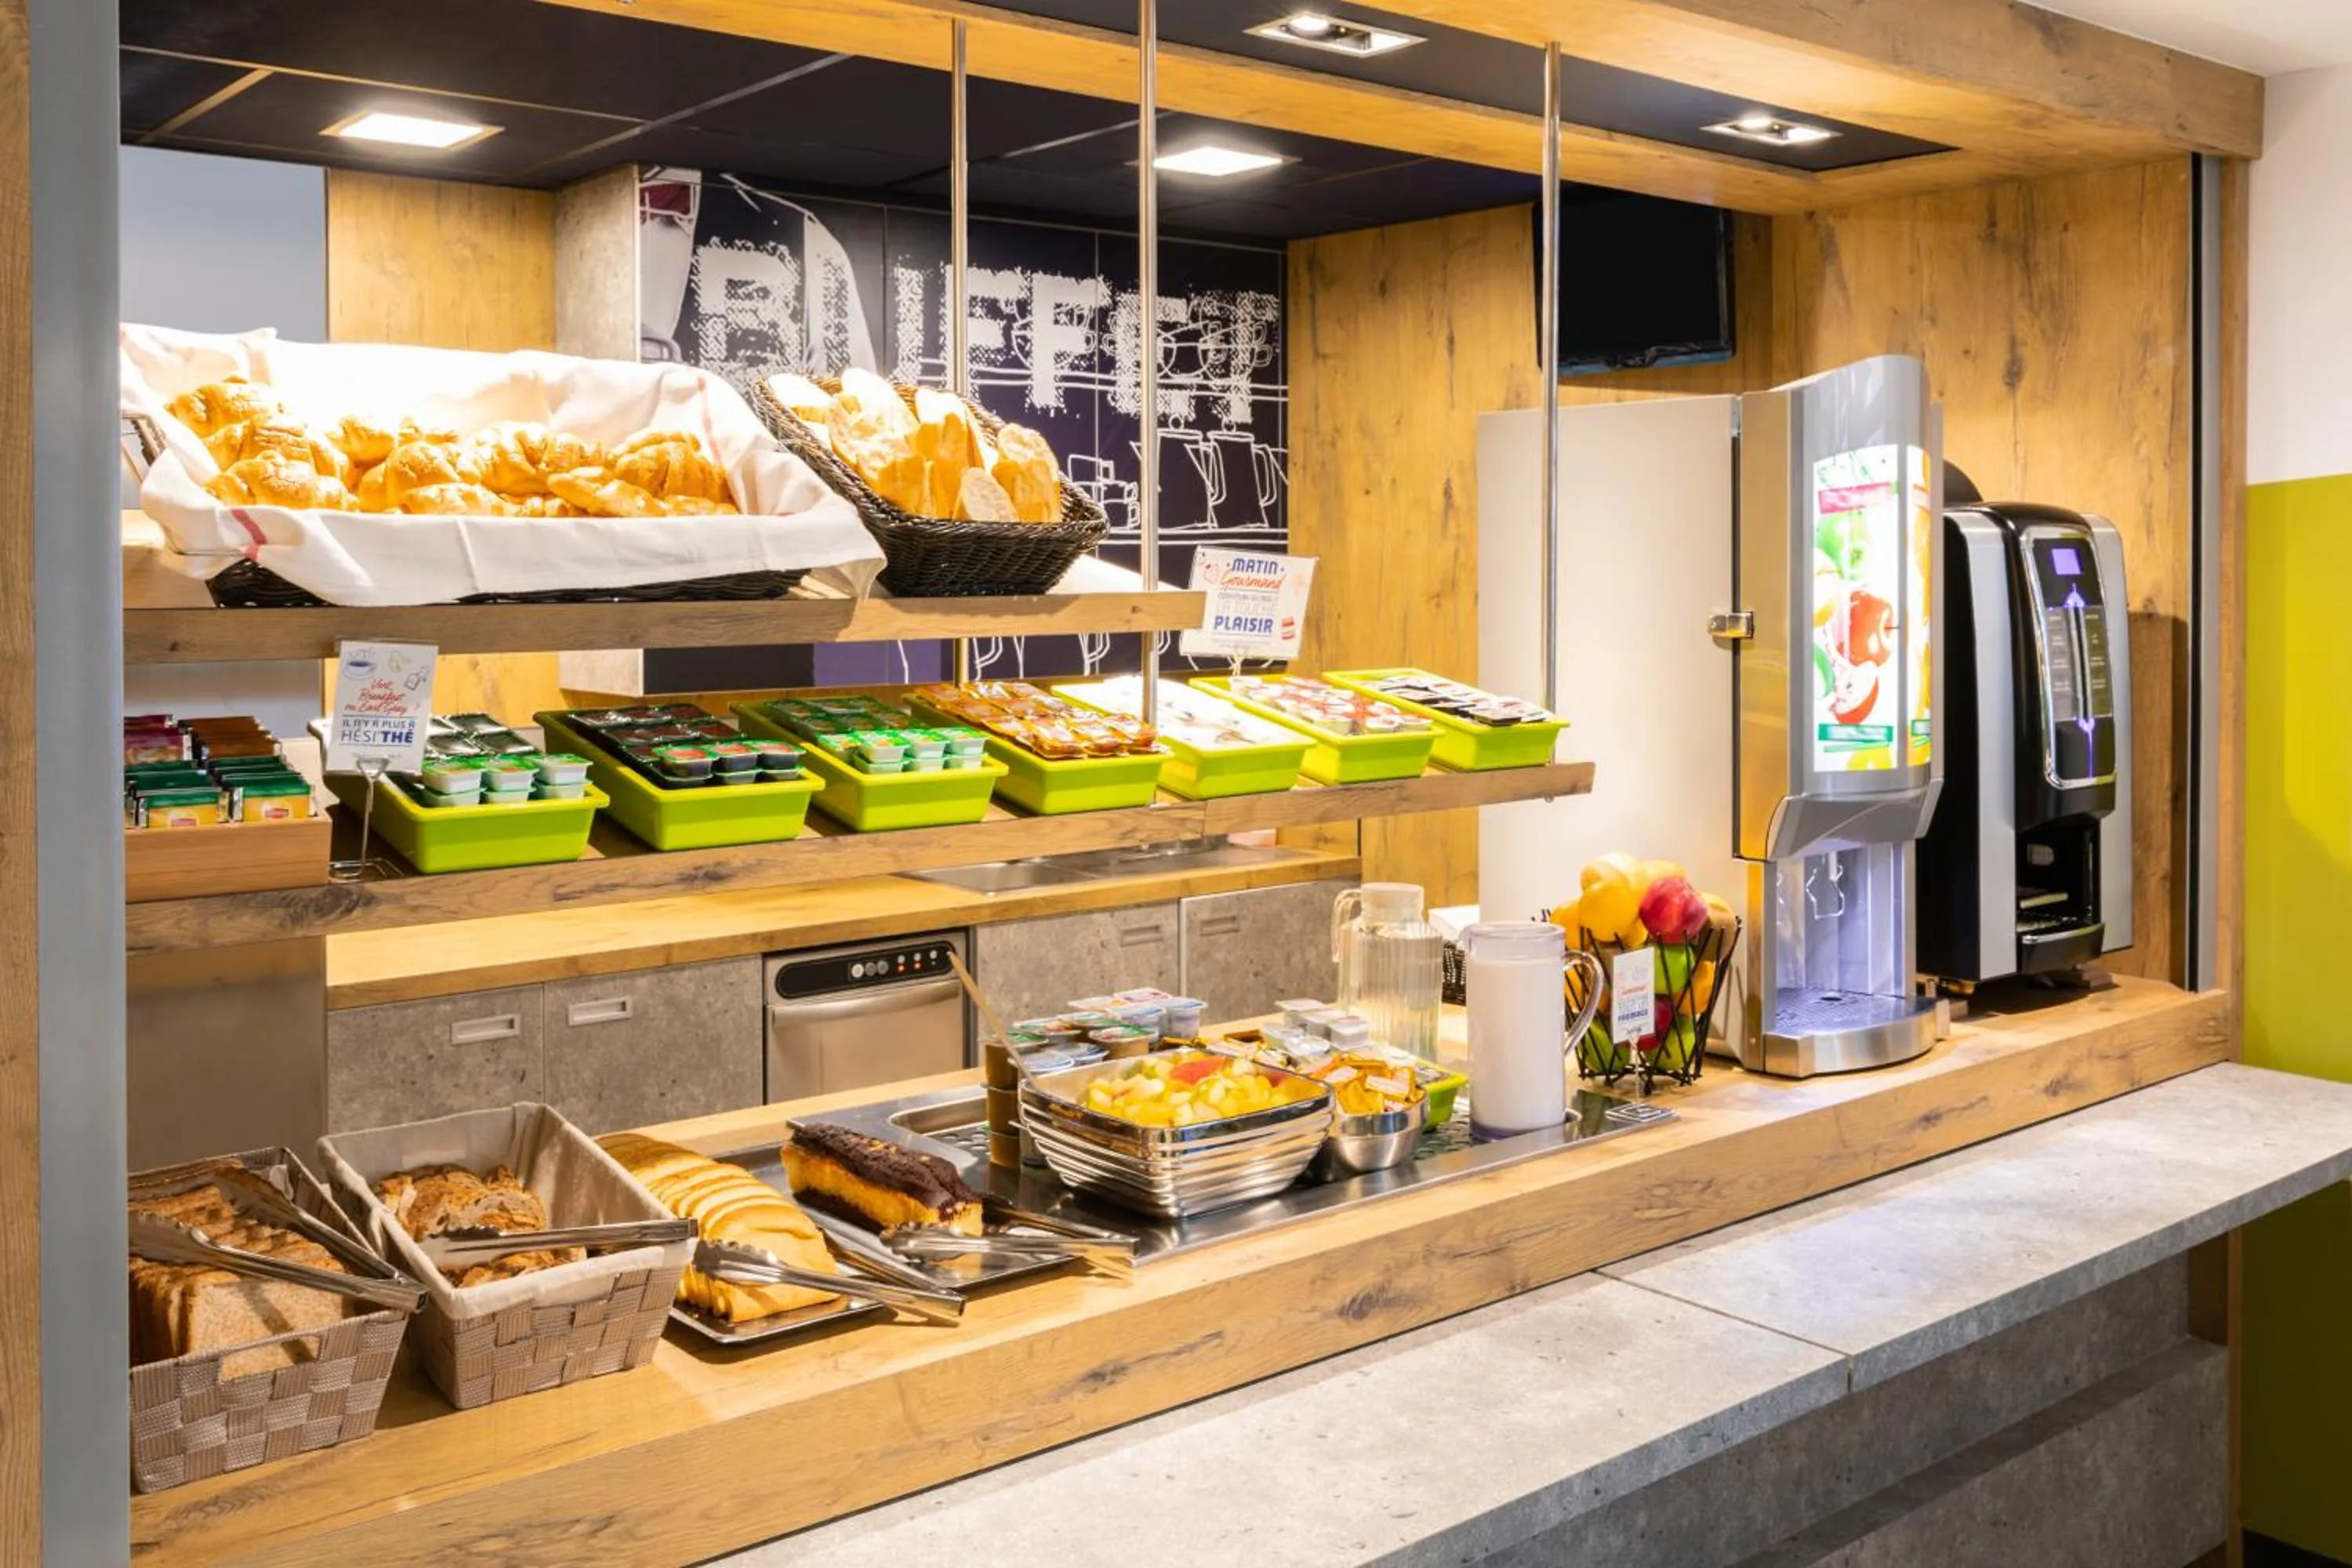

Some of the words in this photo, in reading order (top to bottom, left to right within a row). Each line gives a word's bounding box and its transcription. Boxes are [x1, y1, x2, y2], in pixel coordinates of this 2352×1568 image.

[690, 237, 1280, 424] BUFFET
[1232, 557, 1279, 575] MATIN
[1214, 615, 1274, 633] PLAISIR
[381, 720, 406, 729] PLUS
